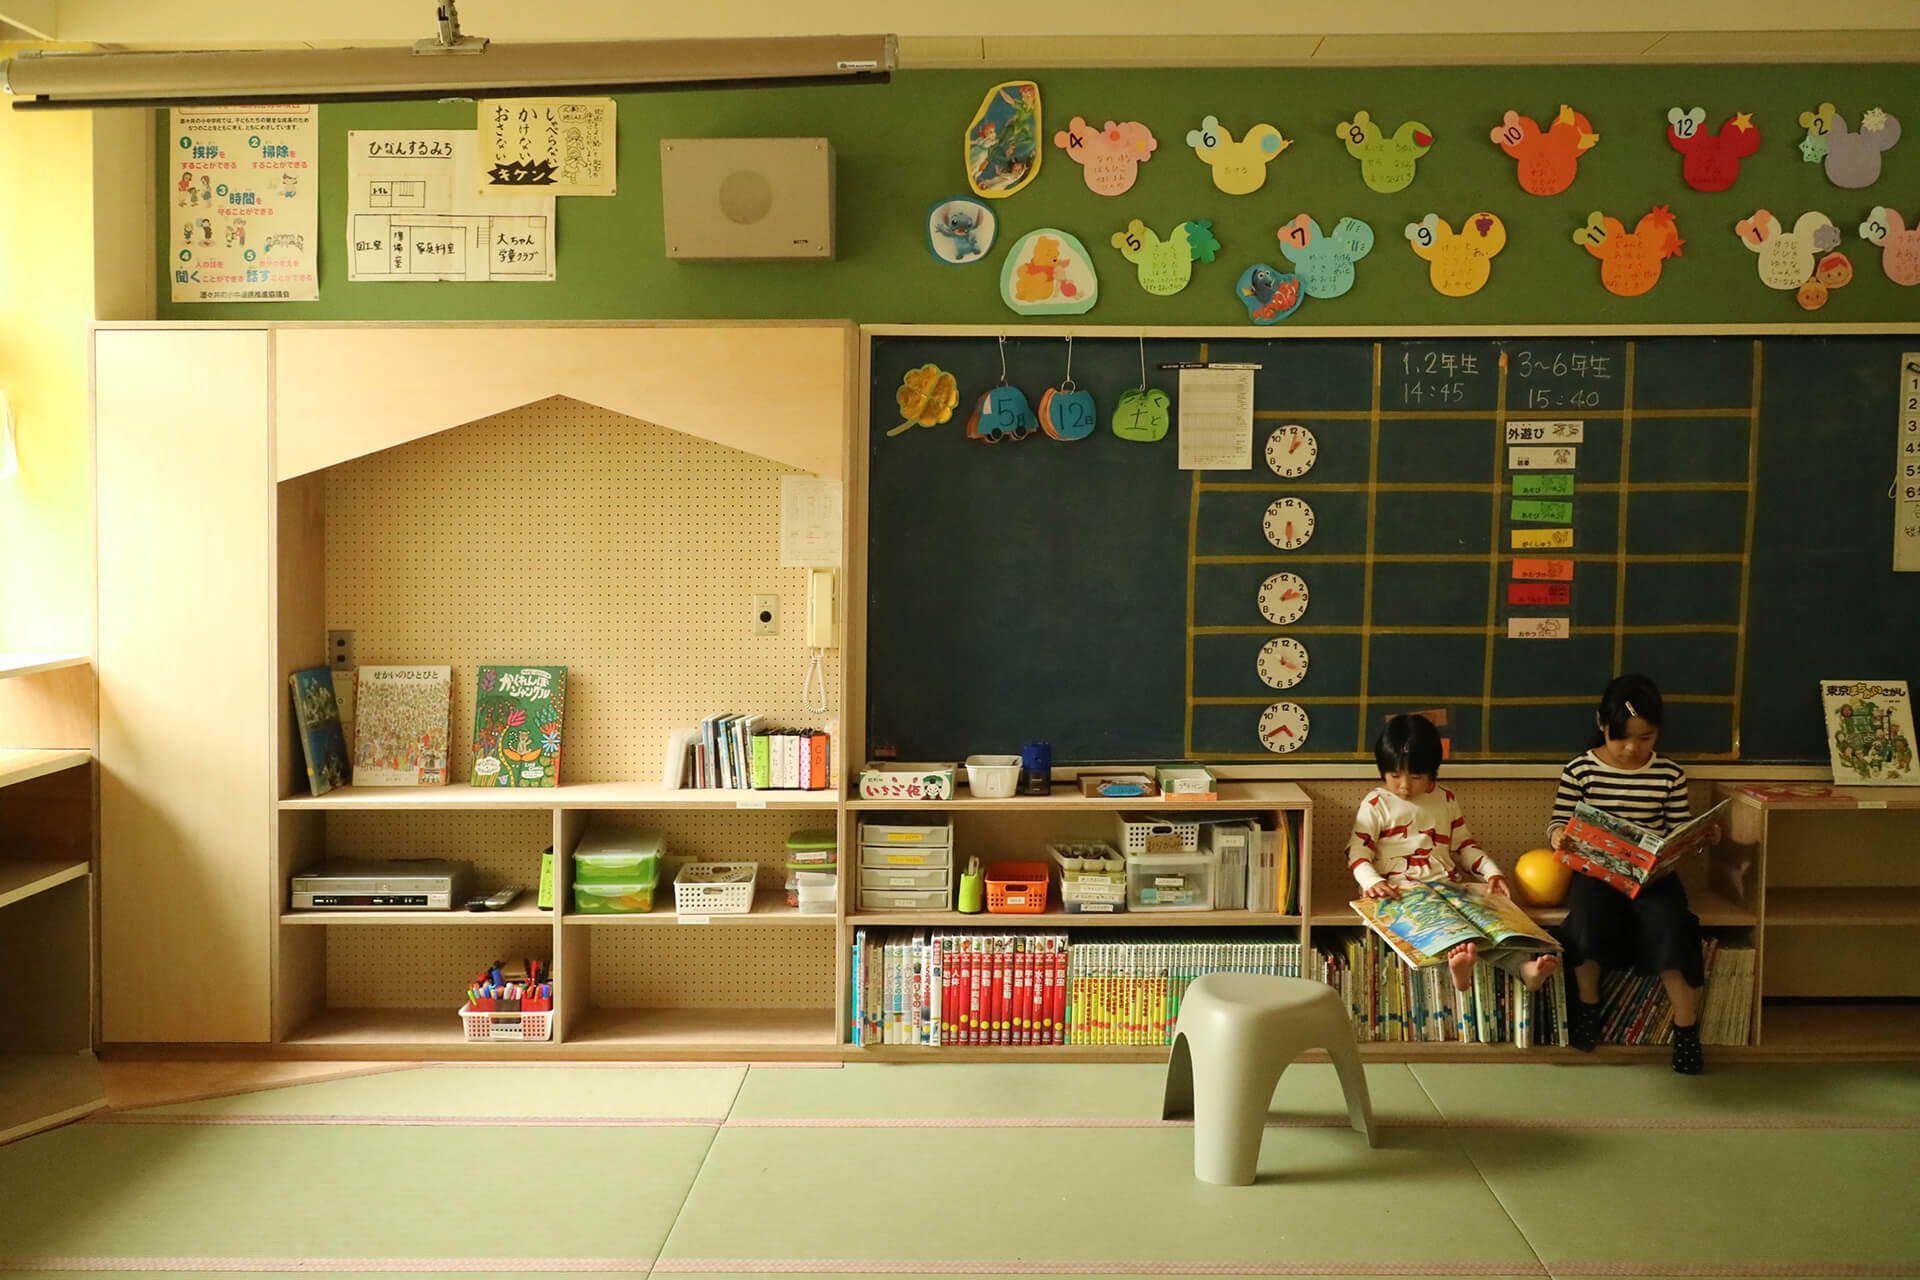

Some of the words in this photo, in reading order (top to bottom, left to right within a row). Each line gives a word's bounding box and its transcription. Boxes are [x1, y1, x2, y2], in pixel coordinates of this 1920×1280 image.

[494, 105, 509, 160] おさない
[1350, 126, 1365, 144] 8
[1678, 119, 1693, 136] 12
[1814, 118, 1828, 135] 2
[1070, 133, 1083, 148] 4
[1204, 132, 1216, 147] 6
[1504, 126, 1521, 145] 10
[193, 145, 225, 159] 挨拶を
[262, 144, 296, 158] 掃除を
[369, 141, 452, 156] ひなんするみち
[181, 161, 237, 169] することができる
[252, 161, 307, 169] することができる
[498, 169, 545, 181] キケン
[229, 192, 262, 205] 時間を
[217, 208, 273, 216] 守ることができる
[1291, 227, 1305, 246] 7
[1417, 227, 1432, 246] 9
[1587, 225, 1606, 244] 11
[1752, 227, 1763, 242] 1
[1870, 221, 1887, 239] 3
[1126, 234, 1141, 251] 5
[1404, 382, 1464, 404] 14:45
[1529, 388, 1600, 408] 15:40
[998, 398, 1024, 426] 5月
[1060, 402, 1094, 430] 12日
[1125, 408, 1149, 431] 土
[1508, 428, 1544, 440] 外遊び
[374, 671, 439, 680] せかいのひとびと
[499, 673, 550, 691] かくれんぼ
[510, 686, 551, 702] ジャングル
[1826, 682, 1906, 699] 東京まちがいさがし
[1260, 724, 1265, 732] 9
